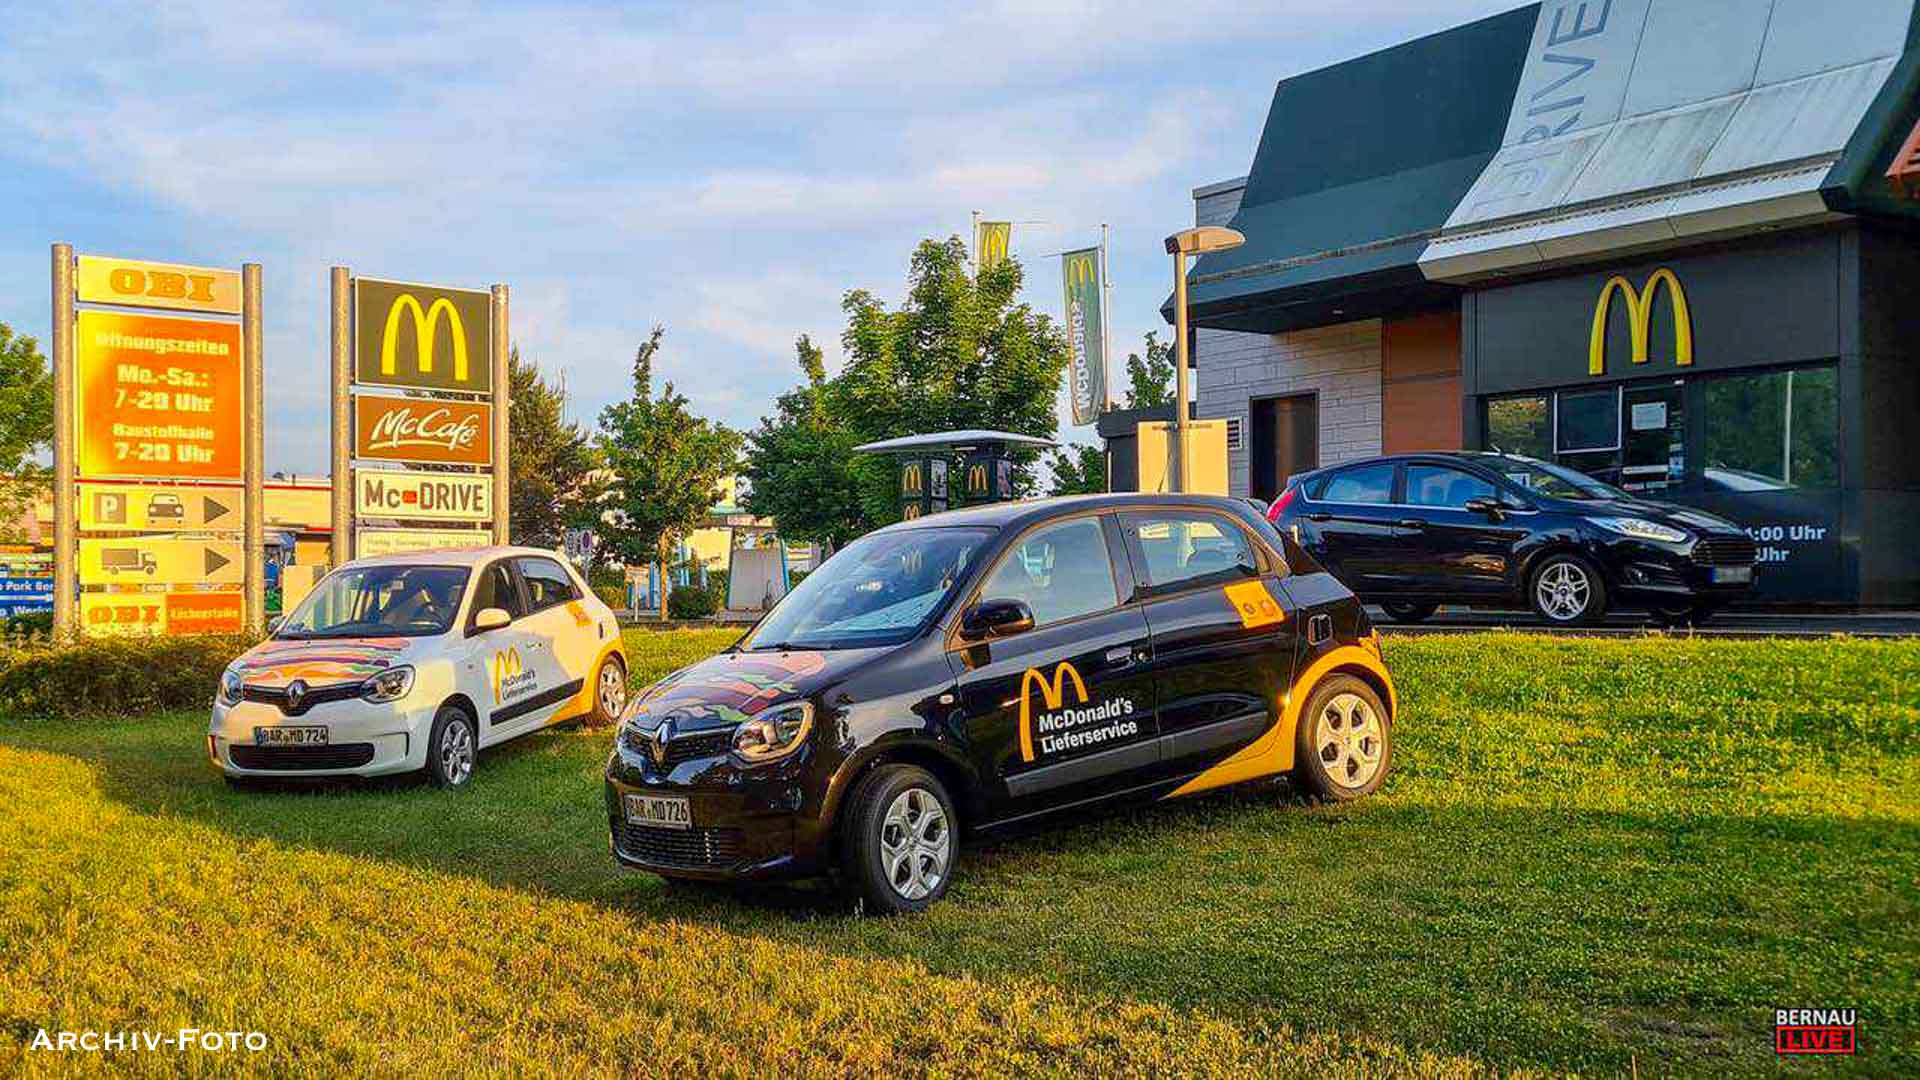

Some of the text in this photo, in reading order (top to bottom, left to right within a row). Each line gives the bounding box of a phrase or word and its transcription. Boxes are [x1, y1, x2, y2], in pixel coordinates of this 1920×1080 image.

[109, 268, 216, 302] OBI
[175, 393, 214, 412] Uhr
[176, 443, 215, 463] Uhr
[1790, 525, 1826, 541] Uhr
[88, 606, 161, 625] OBI
[1039, 698, 1133, 733] McDonald's
[1041, 720, 1138, 754] Lieferservice
